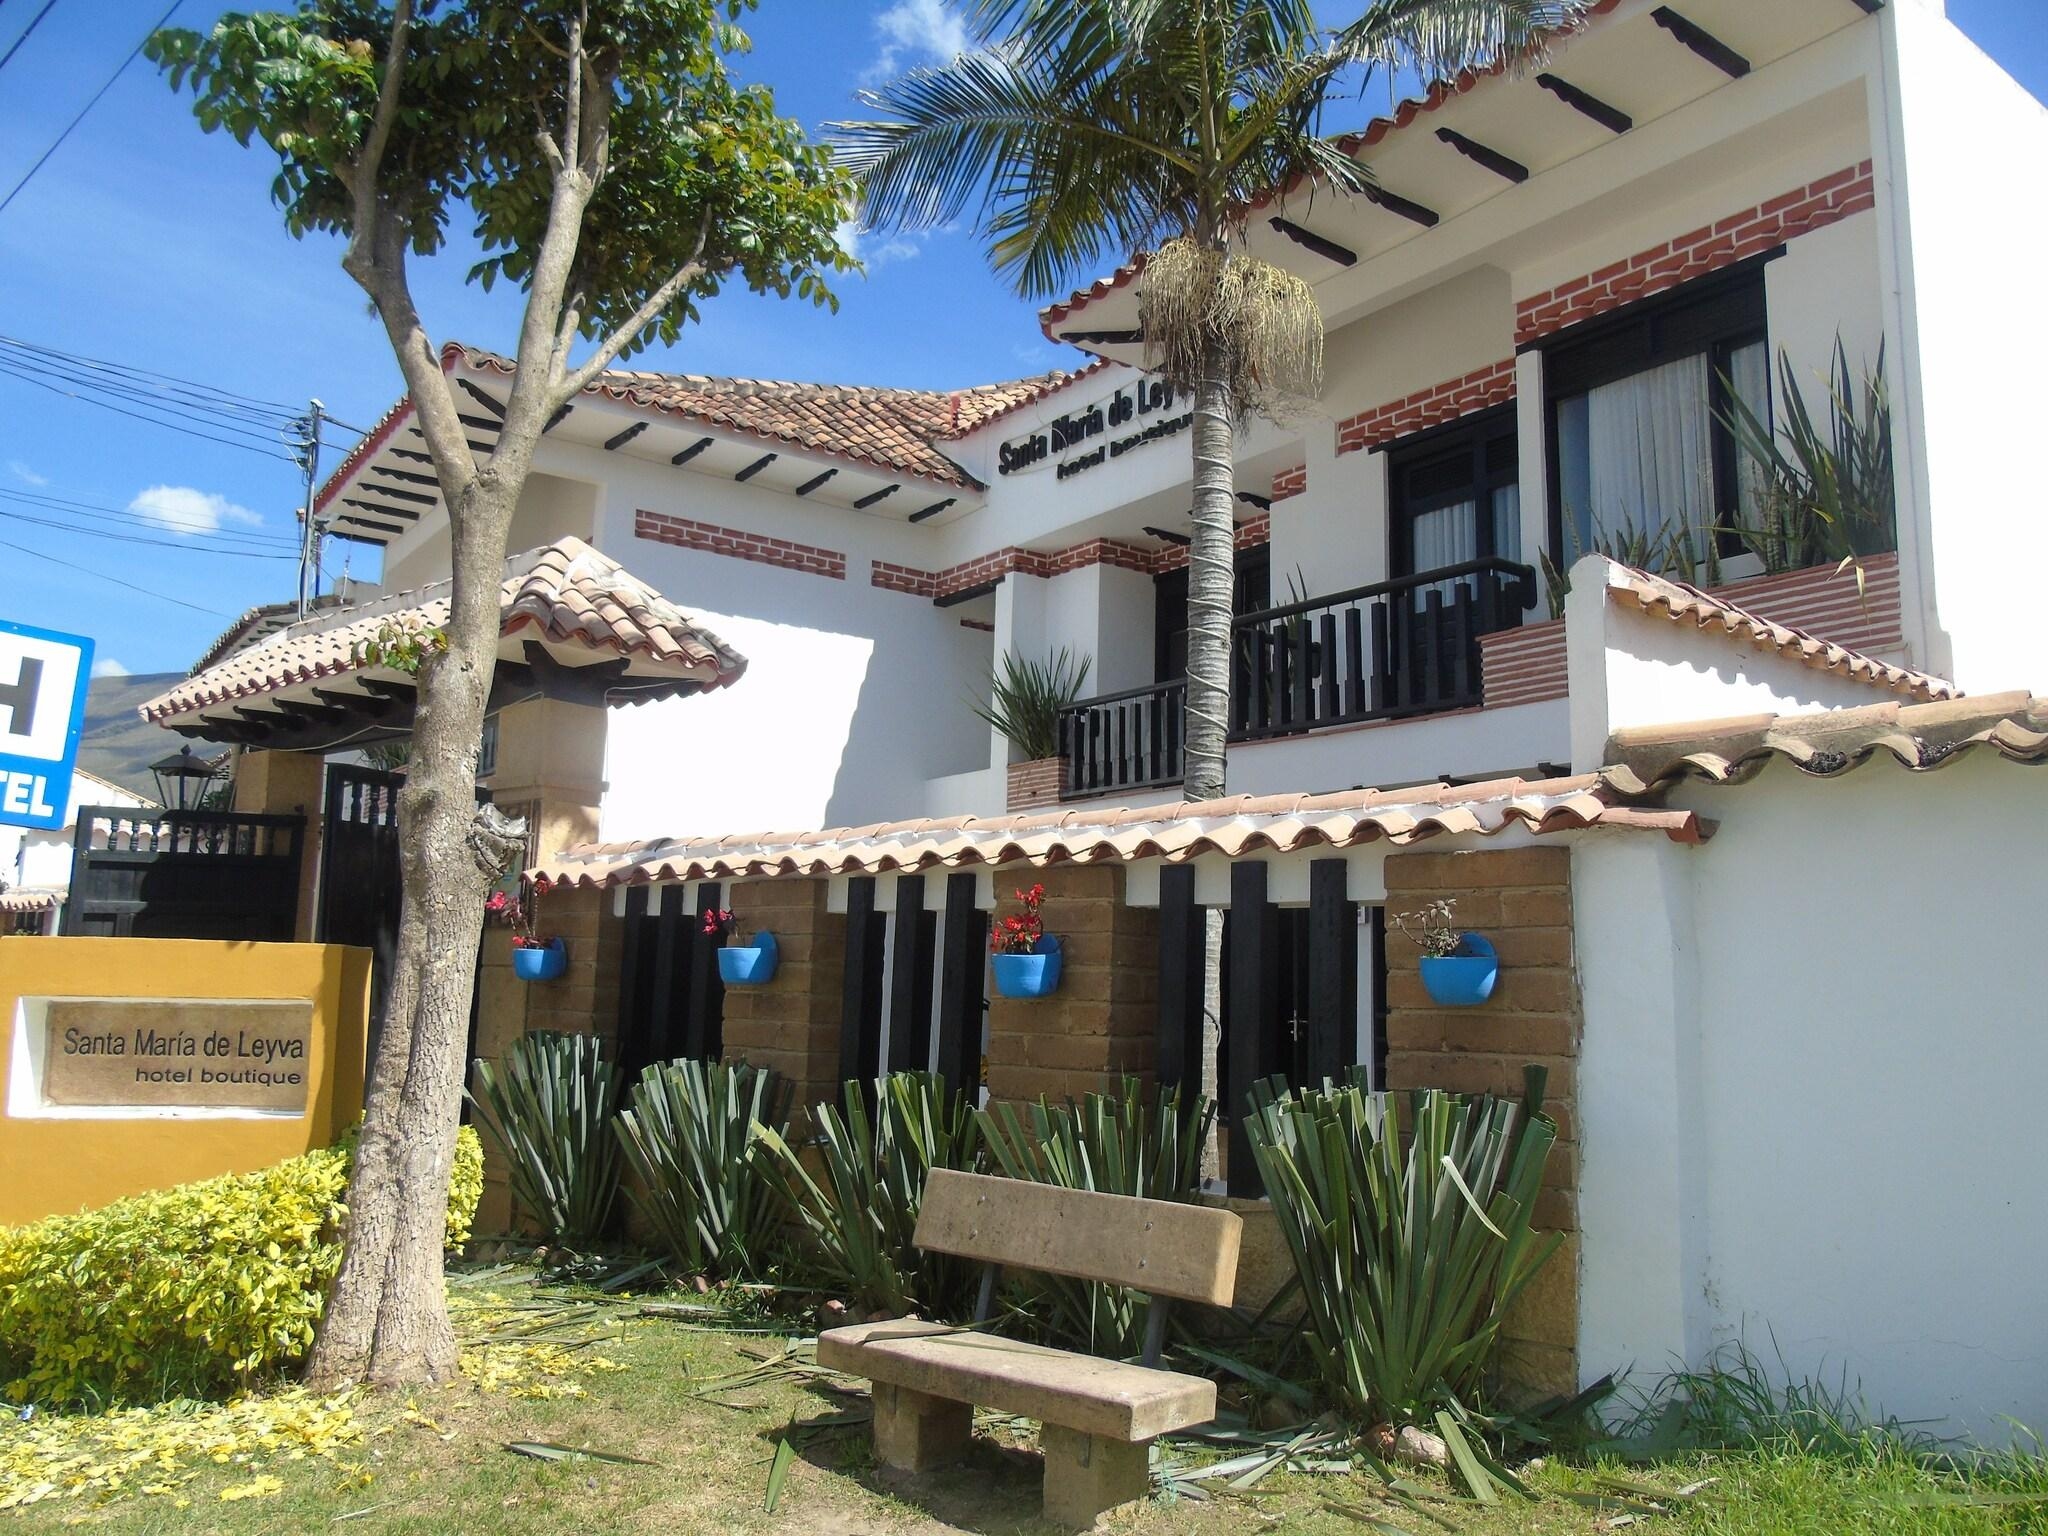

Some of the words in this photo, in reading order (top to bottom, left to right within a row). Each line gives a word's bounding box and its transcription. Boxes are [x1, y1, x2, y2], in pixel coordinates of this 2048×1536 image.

[998, 434, 1047, 475] Santa
[1108, 390, 1132, 427] de
[1137, 378, 1174, 415] Ley
[1057, 446, 1105, 480] hotel
[1110, 412, 1193, 457] boutiqu
[64, 1027, 125, 1055] Santa
[134, 1029, 195, 1056] María
[203, 1031, 230, 1057] de
[238, 1030, 303, 1064] Leyva
[135, 1068, 192, 1083] hotel
[201, 1068, 301, 1087] boutique
